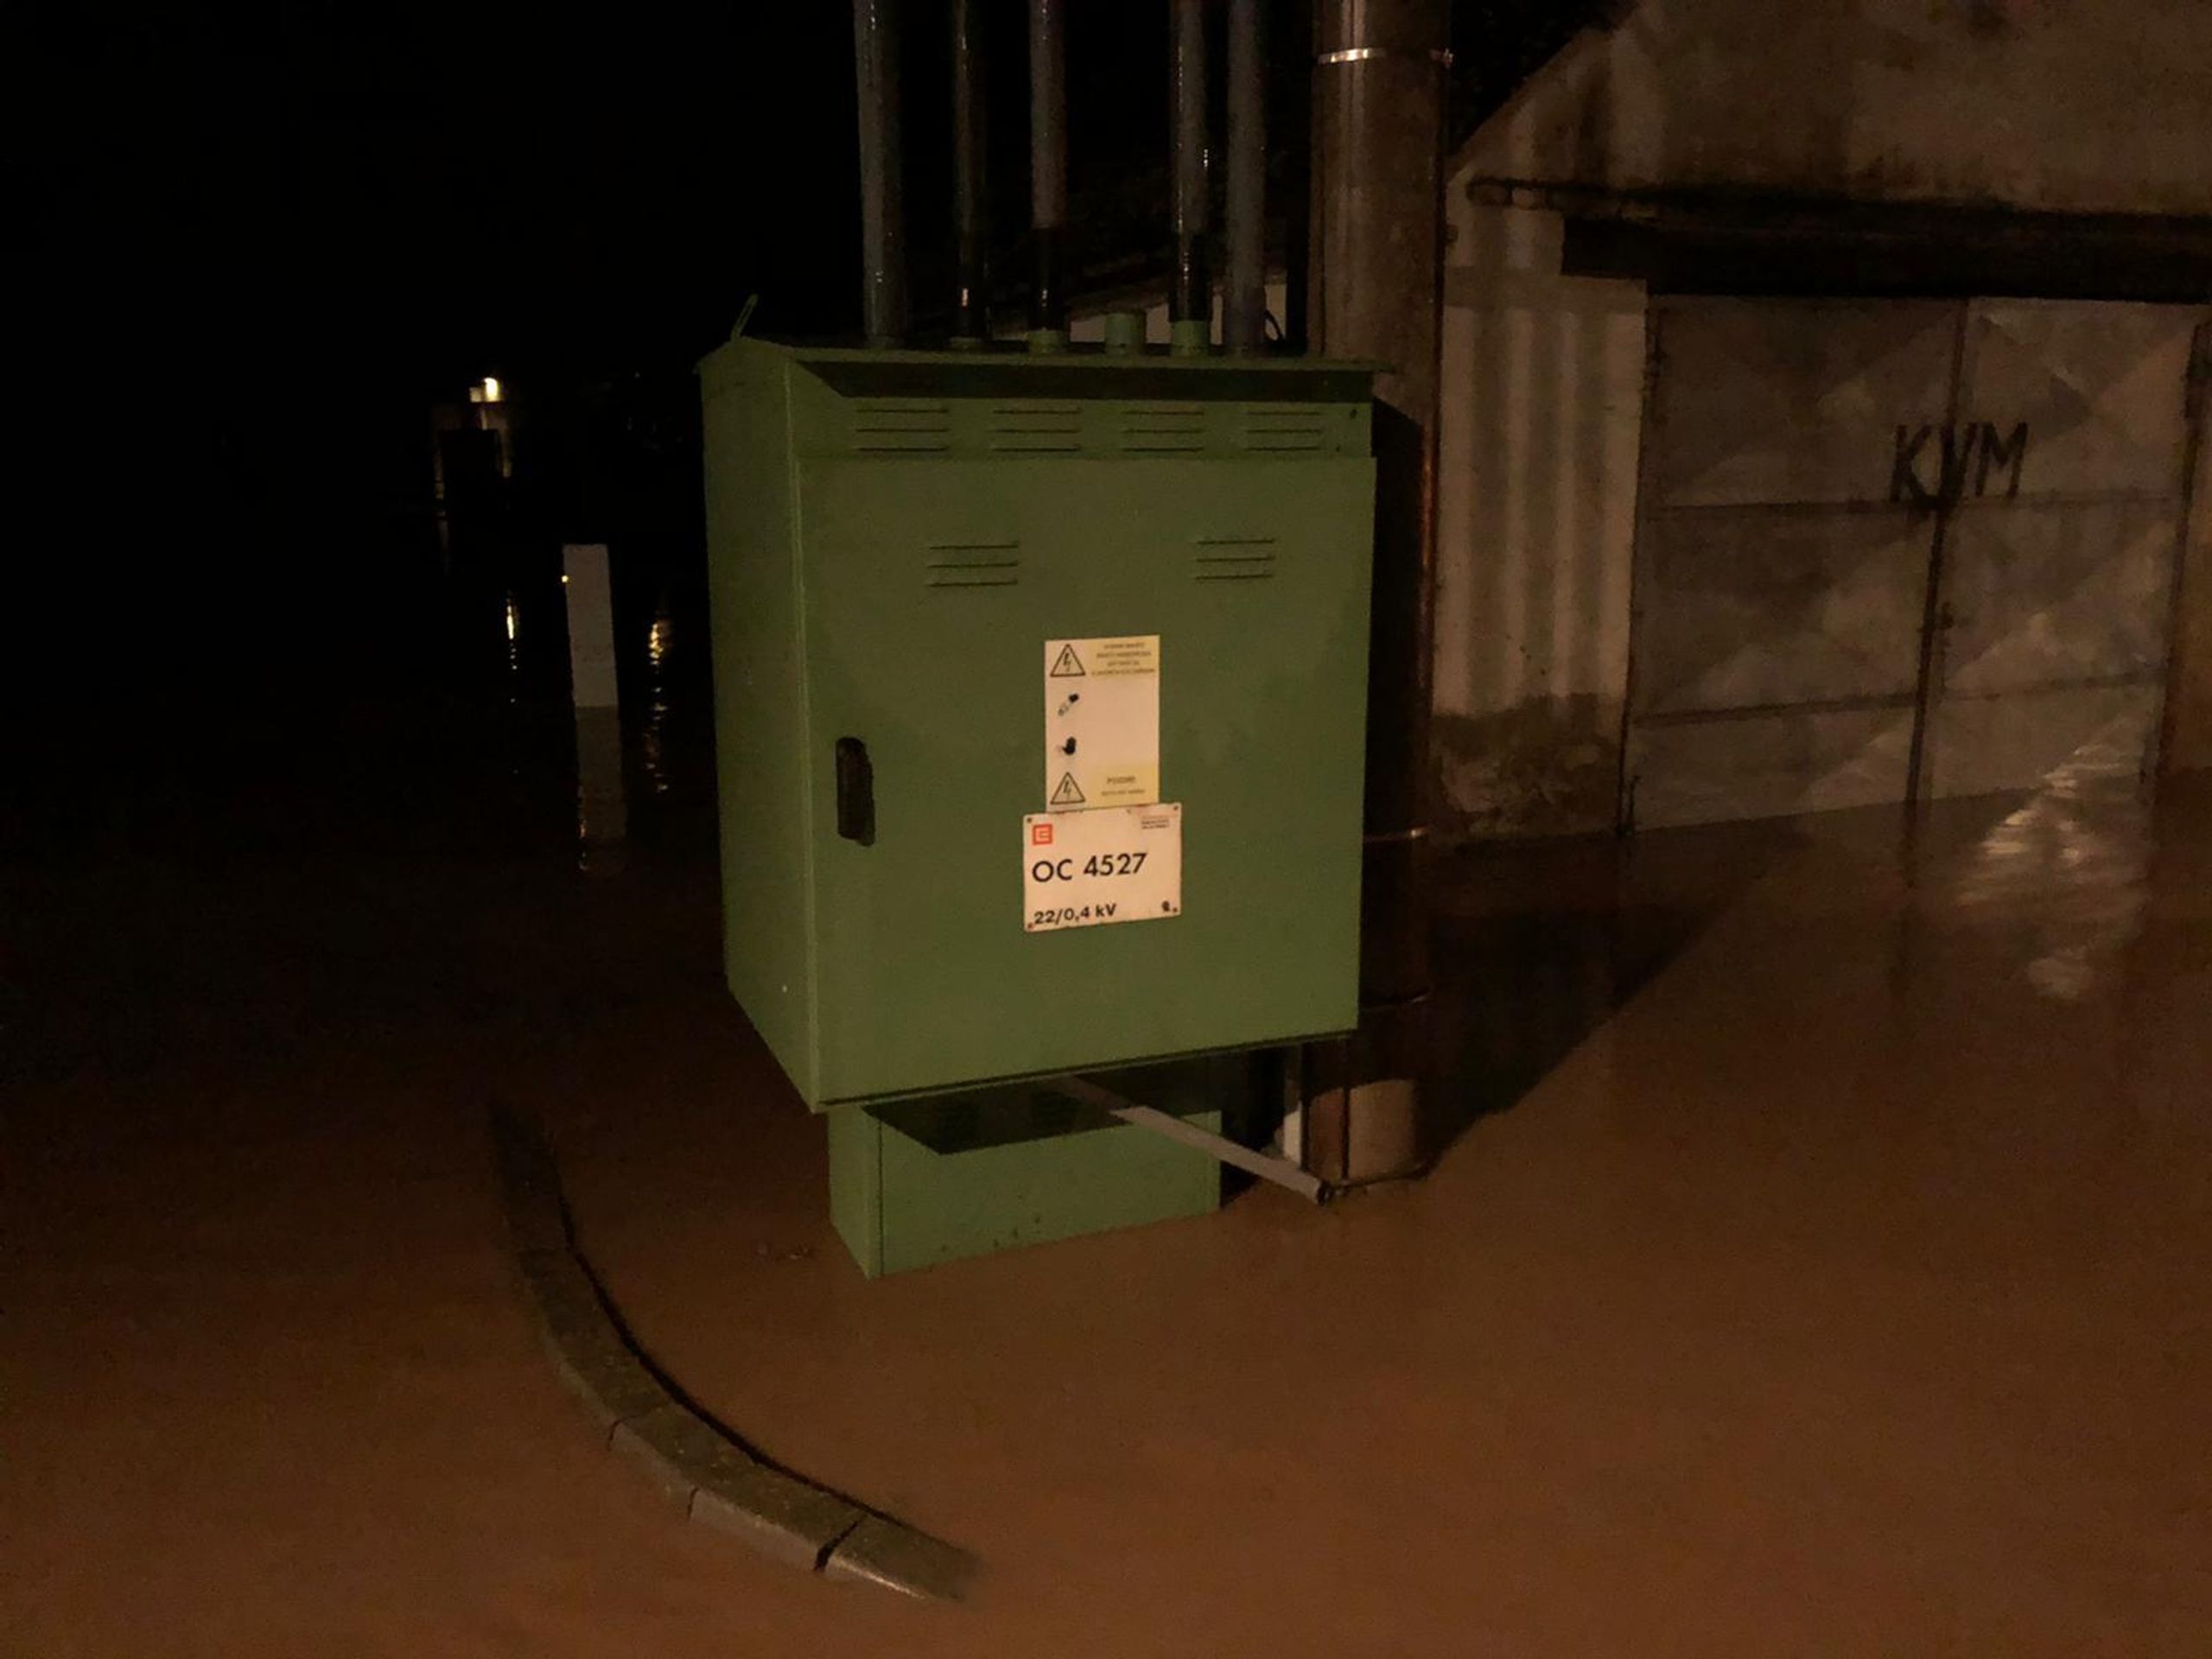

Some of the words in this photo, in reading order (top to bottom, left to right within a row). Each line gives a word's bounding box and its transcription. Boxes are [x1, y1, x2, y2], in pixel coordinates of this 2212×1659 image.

[1890, 421, 2028, 503] KVM
[1032, 858, 1073, 882] OC
[1084, 852, 1147, 876] 4527
[1033, 906, 1090, 925] 22/0,4
[1096, 903, 1116, 918] kV
